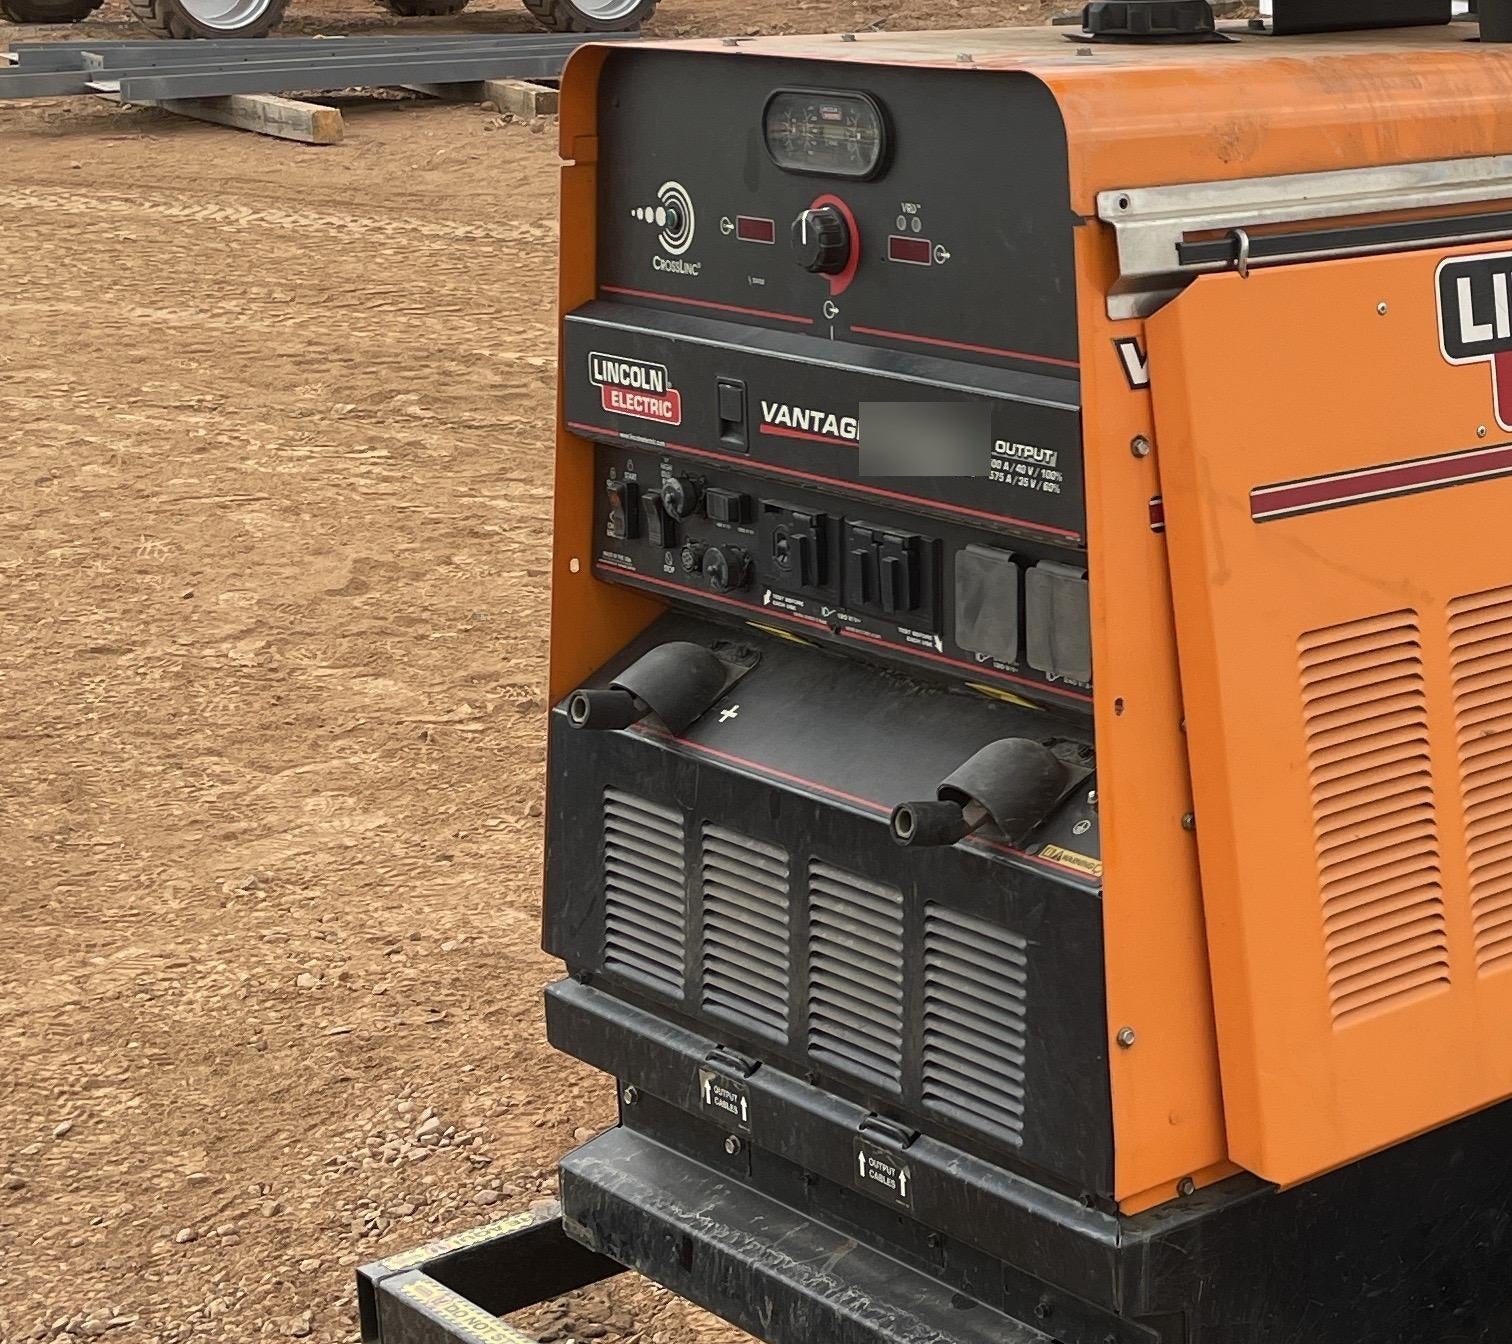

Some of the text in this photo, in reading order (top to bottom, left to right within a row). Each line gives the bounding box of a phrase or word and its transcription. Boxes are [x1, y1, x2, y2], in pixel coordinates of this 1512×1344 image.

[593, 358, 664, 393] LINCOLN
[610, 390, 673, 418] ELECTRIC
[761, 400, 859, 441] VANTAG
[995, 440, 1053, 462] OUTPUT
[713, 1085, 738, 1103] OUTPUT
[714, 1096, 739, 1115] CABLES
[868, 1157, 896, 1176] OUTPUT
[868, 1169, 896, 1189] CABLES
[449, 1303, 467, 1319] DO
[467, 1316, 495, 1336] NOT
